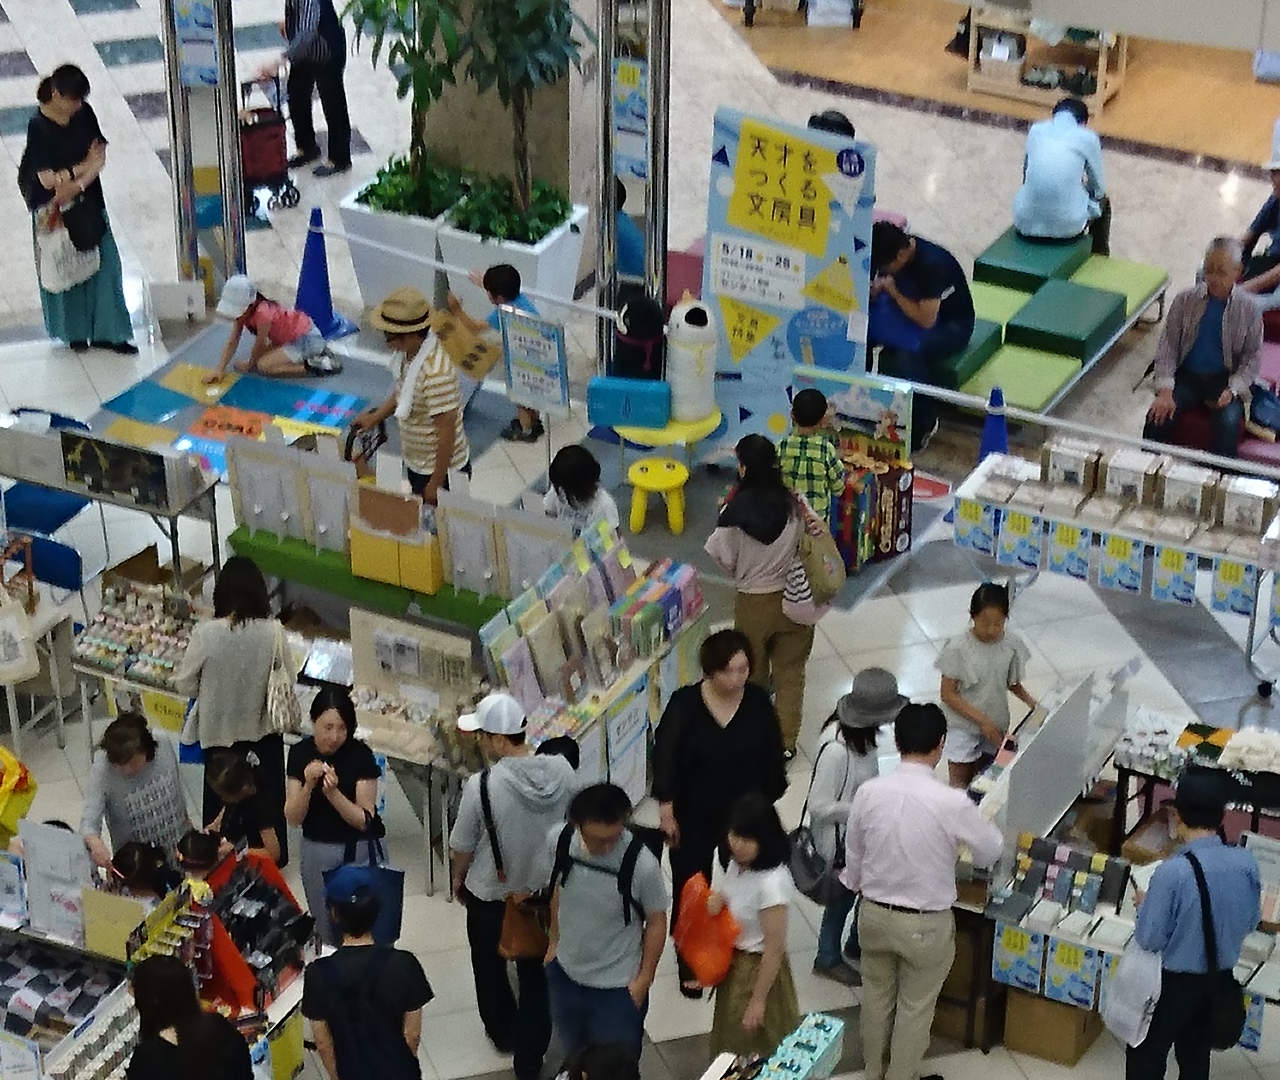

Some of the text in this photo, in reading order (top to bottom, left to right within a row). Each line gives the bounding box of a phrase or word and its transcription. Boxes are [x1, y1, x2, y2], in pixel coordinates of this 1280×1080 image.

[748, 134, 819, 176] 天才を
[748, 168, 819, 201] つくる
[747, 191, 817, 233] 文房具
